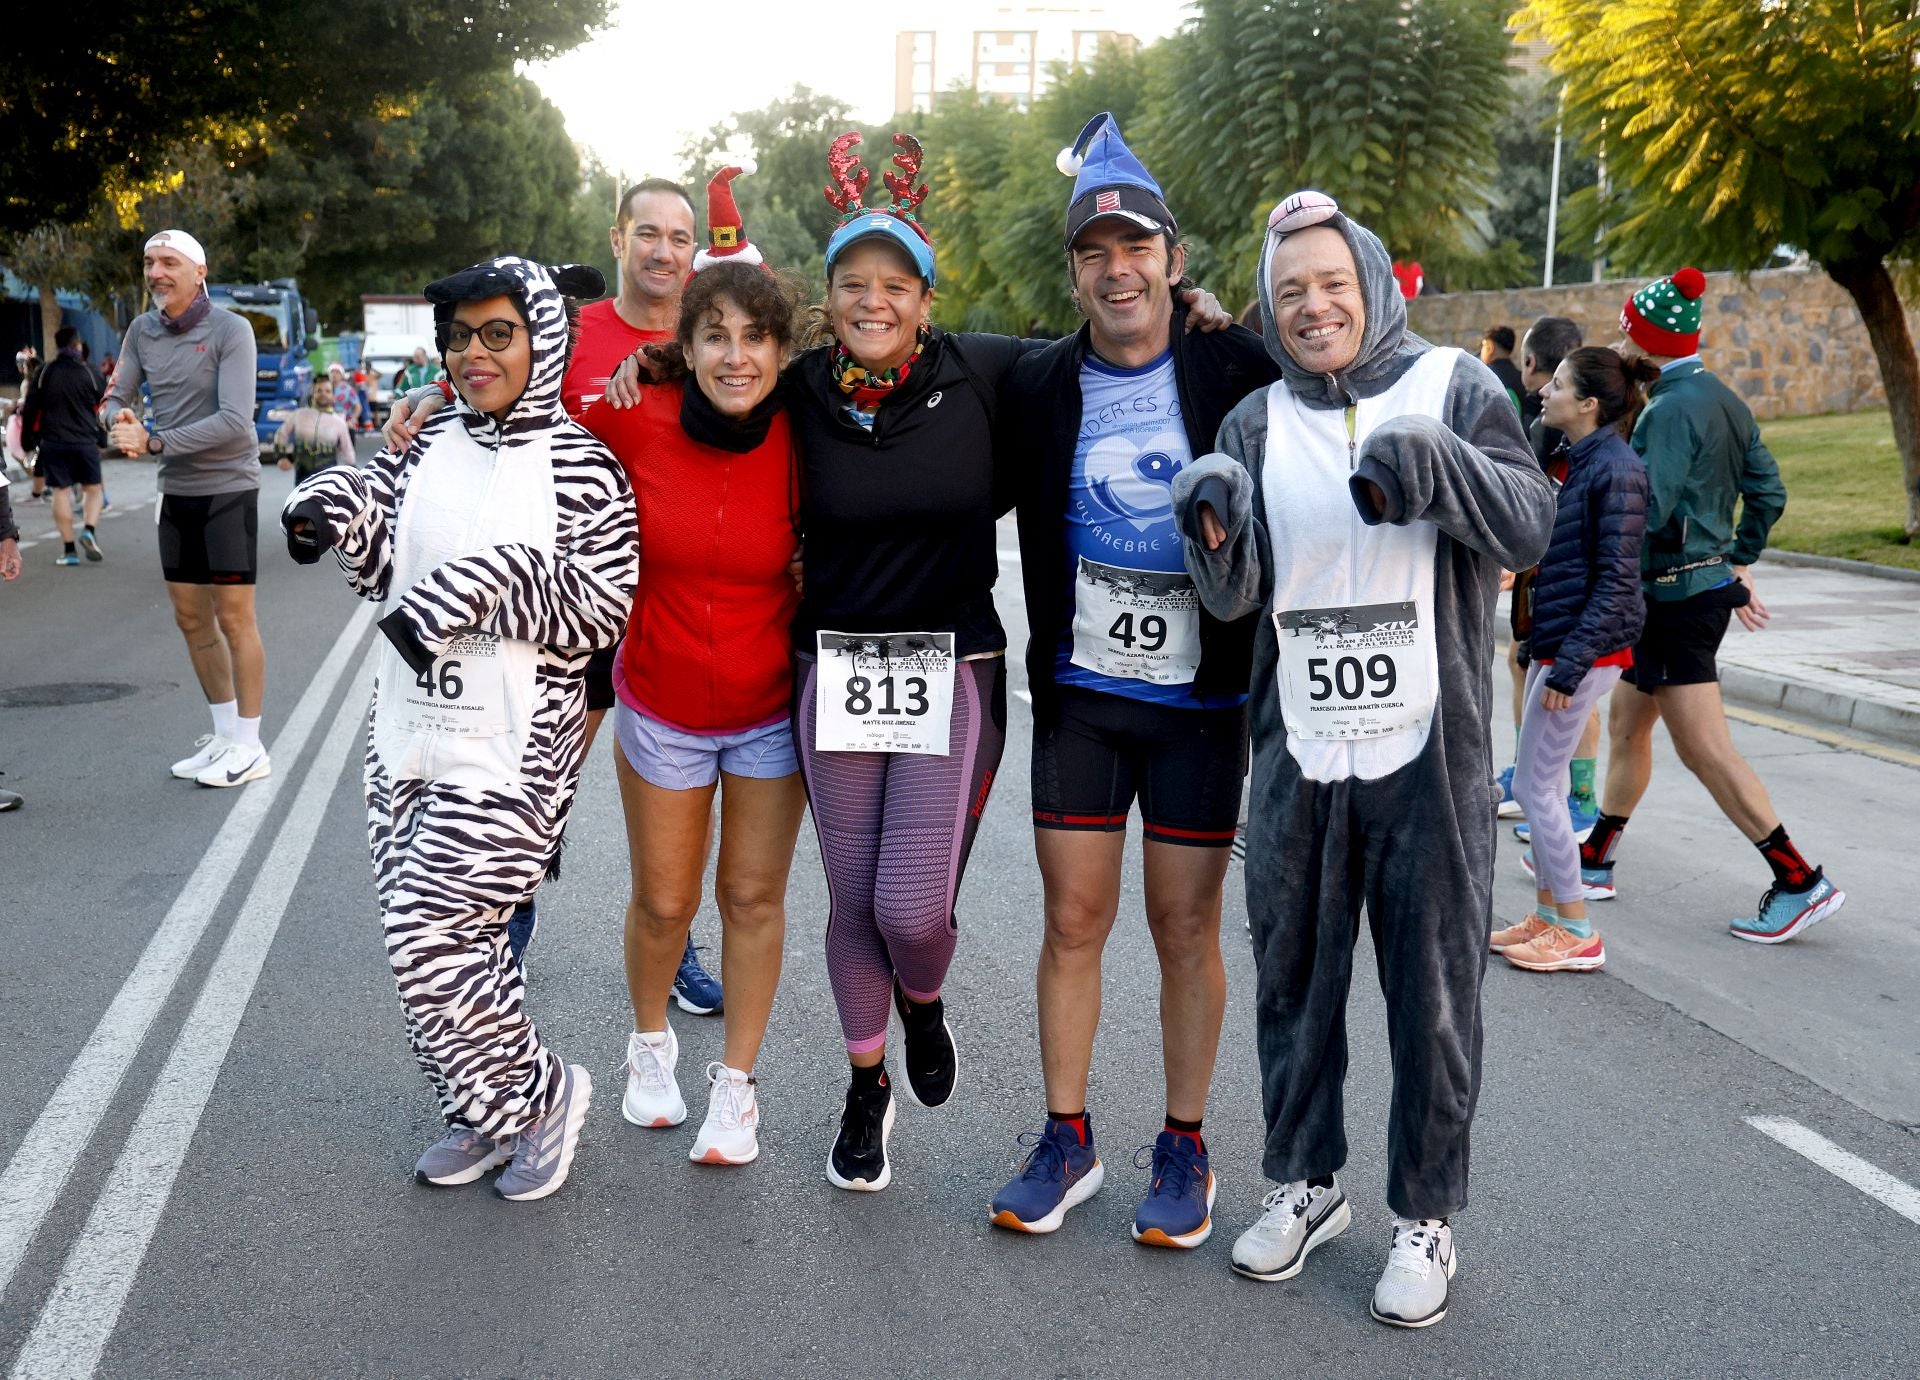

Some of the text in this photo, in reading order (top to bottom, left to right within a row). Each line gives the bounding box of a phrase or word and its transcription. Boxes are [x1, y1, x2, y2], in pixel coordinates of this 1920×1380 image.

[1133, 396, 1157, 412] ES
[1167, 400, 1182, 420] D
[1076, 501, 1161, 552] ULTRAEBRE
[1109, 612, 1167, 651] 49
[1362, 630, 1414, 639] CARRERA
[1370, 619, 1417, 632] XIV
[1357, 638, 1415, 648] PALMILLA
[1359, 634, 1415, 643] SILVESTRE
[416, 660, 464, 700] 46
[1308, 653, 1397, 701] 509
[845, 676, 930, 716] 813
[1806, 884, 1829, 906] HOKA
